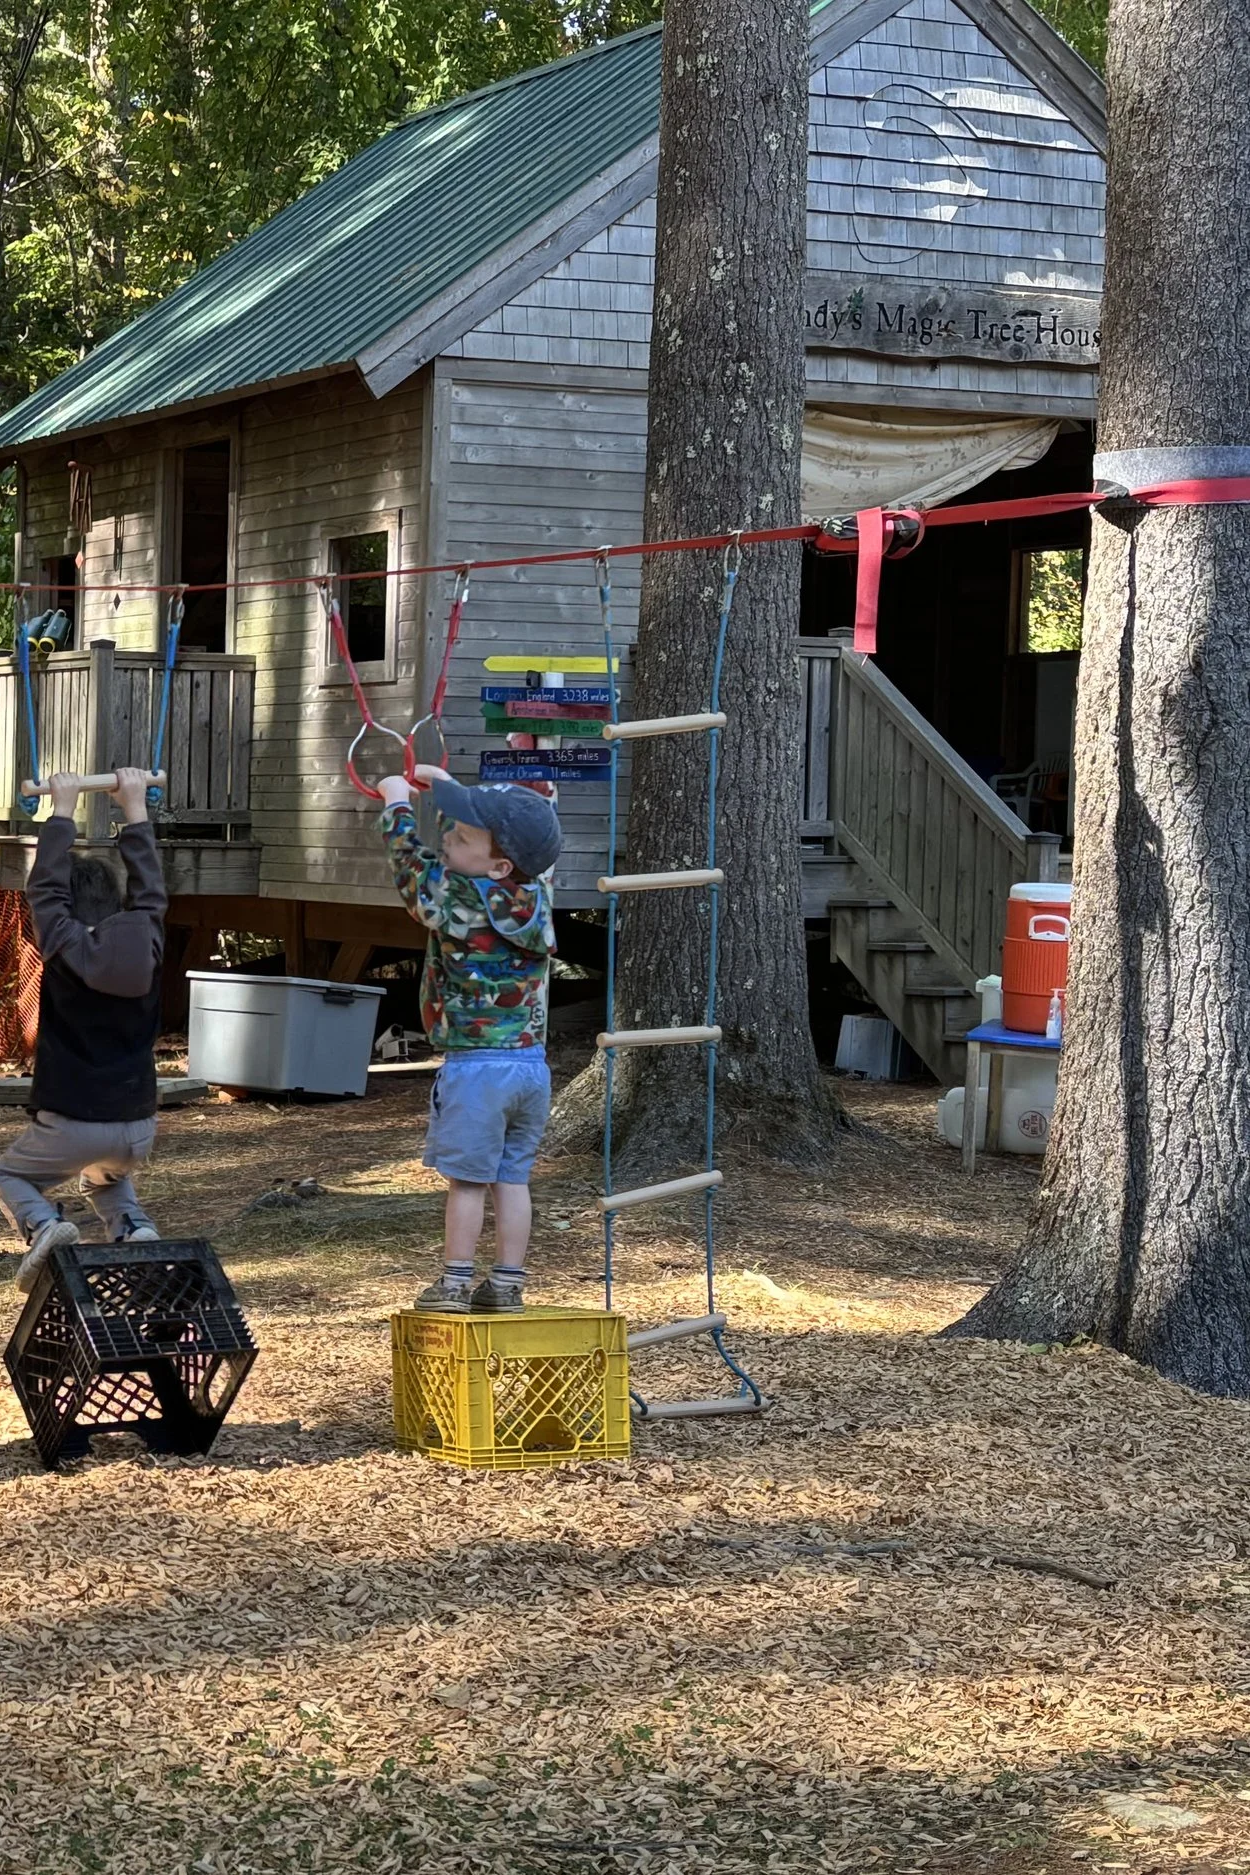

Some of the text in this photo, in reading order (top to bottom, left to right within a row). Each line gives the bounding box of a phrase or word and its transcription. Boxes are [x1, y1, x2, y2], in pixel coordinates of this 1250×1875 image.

[876, 302, 956, 345] Magic
[967, 309, 1025, 343] Tree
[577, 749, 599, 761] miles
